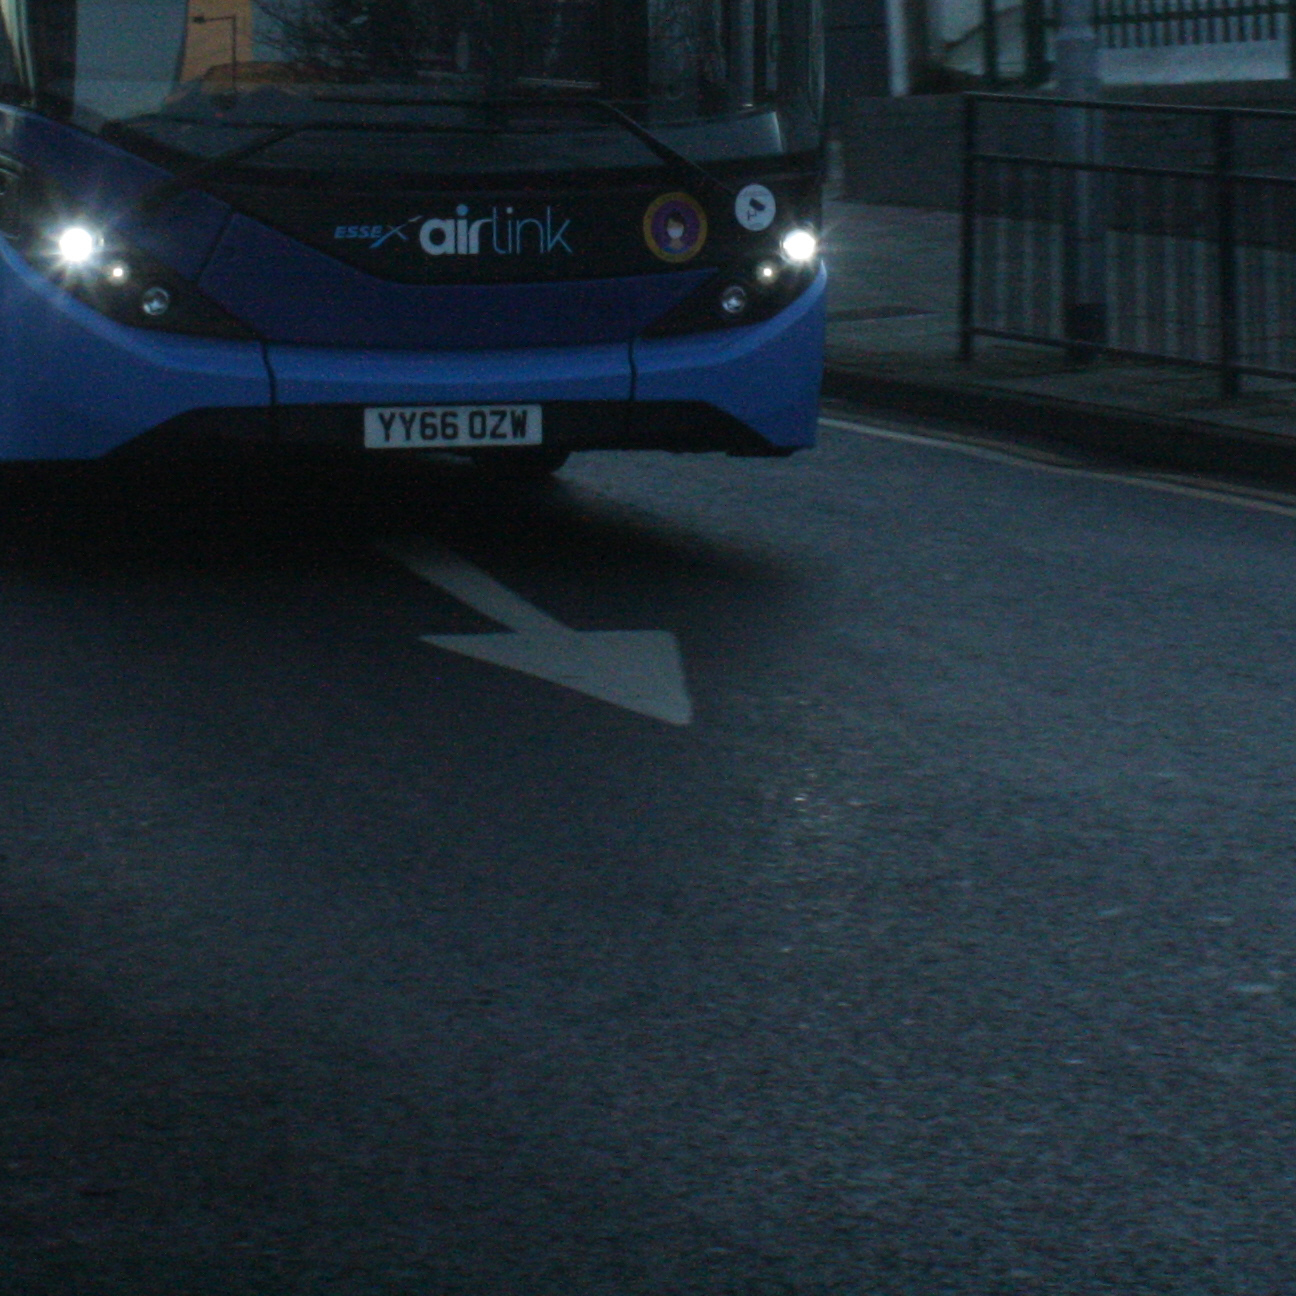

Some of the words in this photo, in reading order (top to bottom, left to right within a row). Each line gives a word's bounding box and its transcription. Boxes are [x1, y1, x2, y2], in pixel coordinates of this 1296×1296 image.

[419, 204, 573, 256] airlink
[378, 410, 459, 442] YY66
[468, 409, 529, 440] OZW
